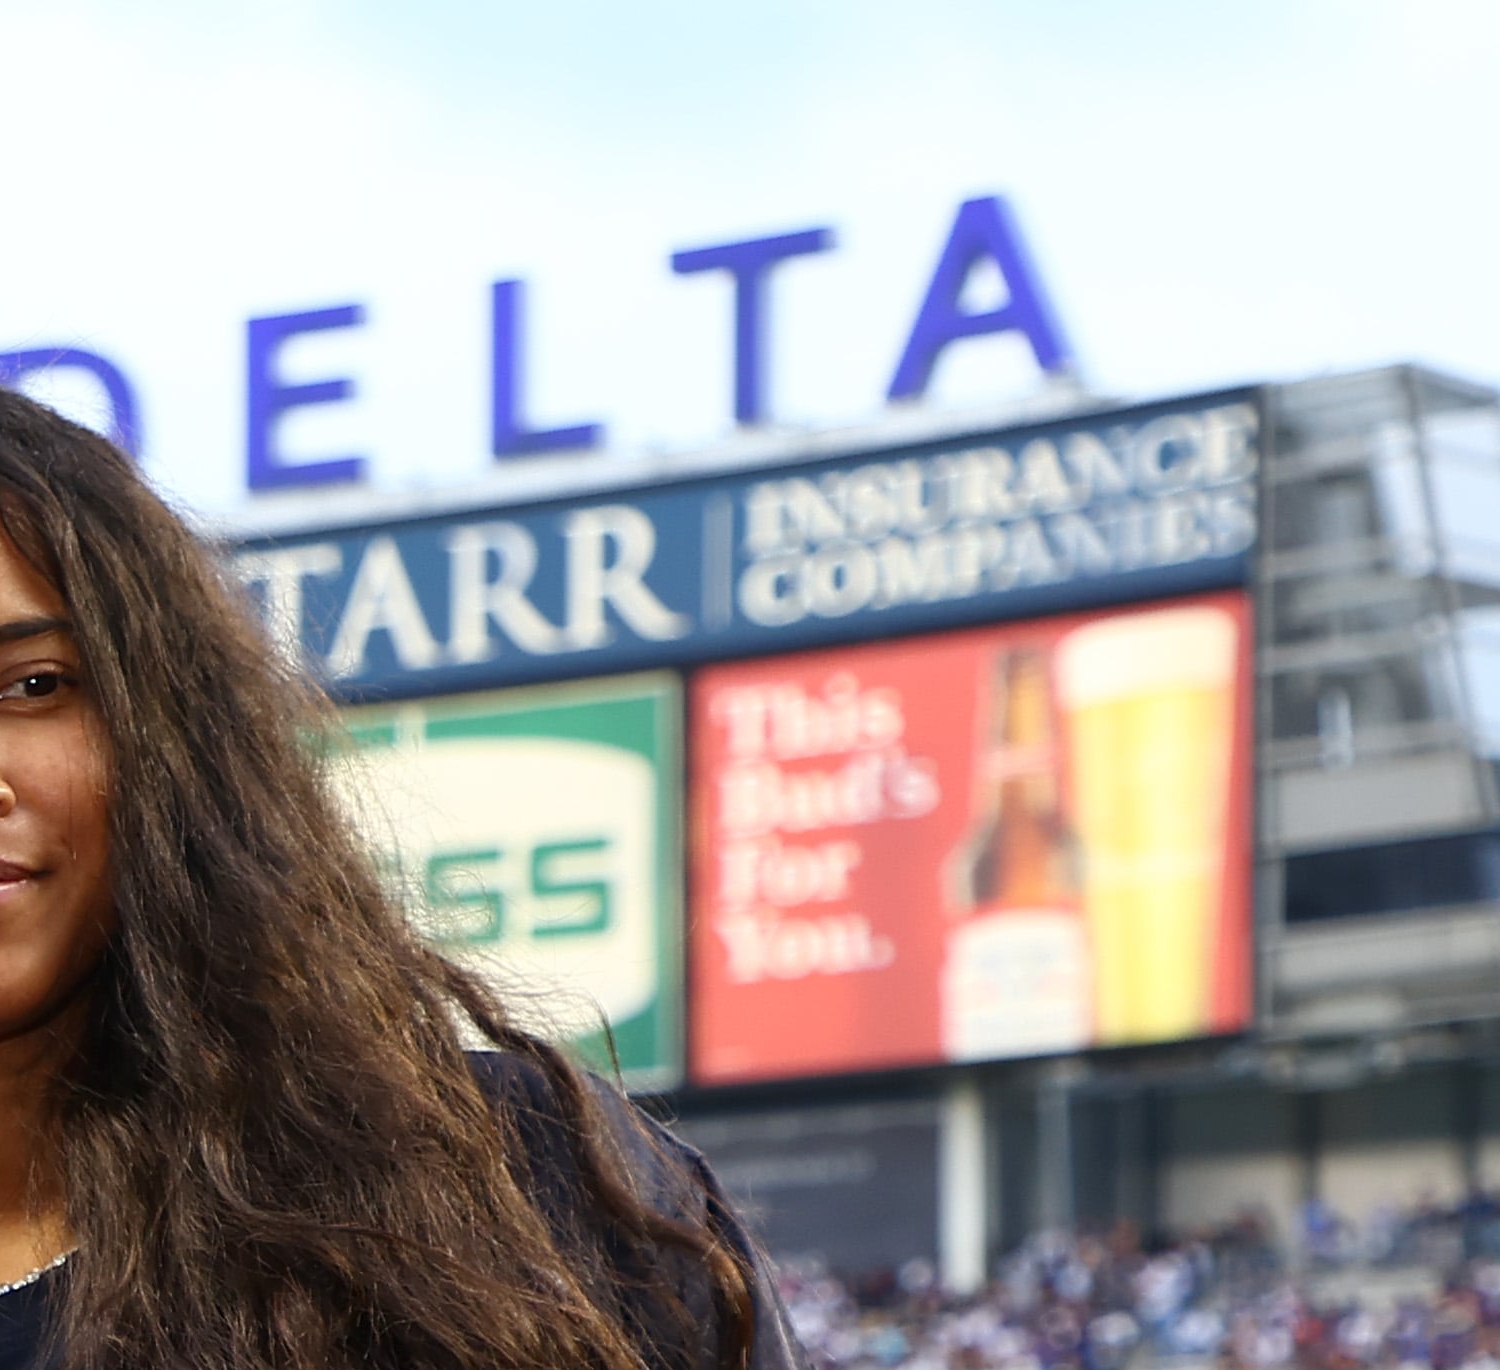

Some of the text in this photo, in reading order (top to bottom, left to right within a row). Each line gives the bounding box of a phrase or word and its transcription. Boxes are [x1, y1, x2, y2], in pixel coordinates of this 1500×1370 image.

[747, 404, 1262, 555] INSURANCE
[738, 484, 1262, 628] COMPANIES
[709, 672, 904, 759] This
